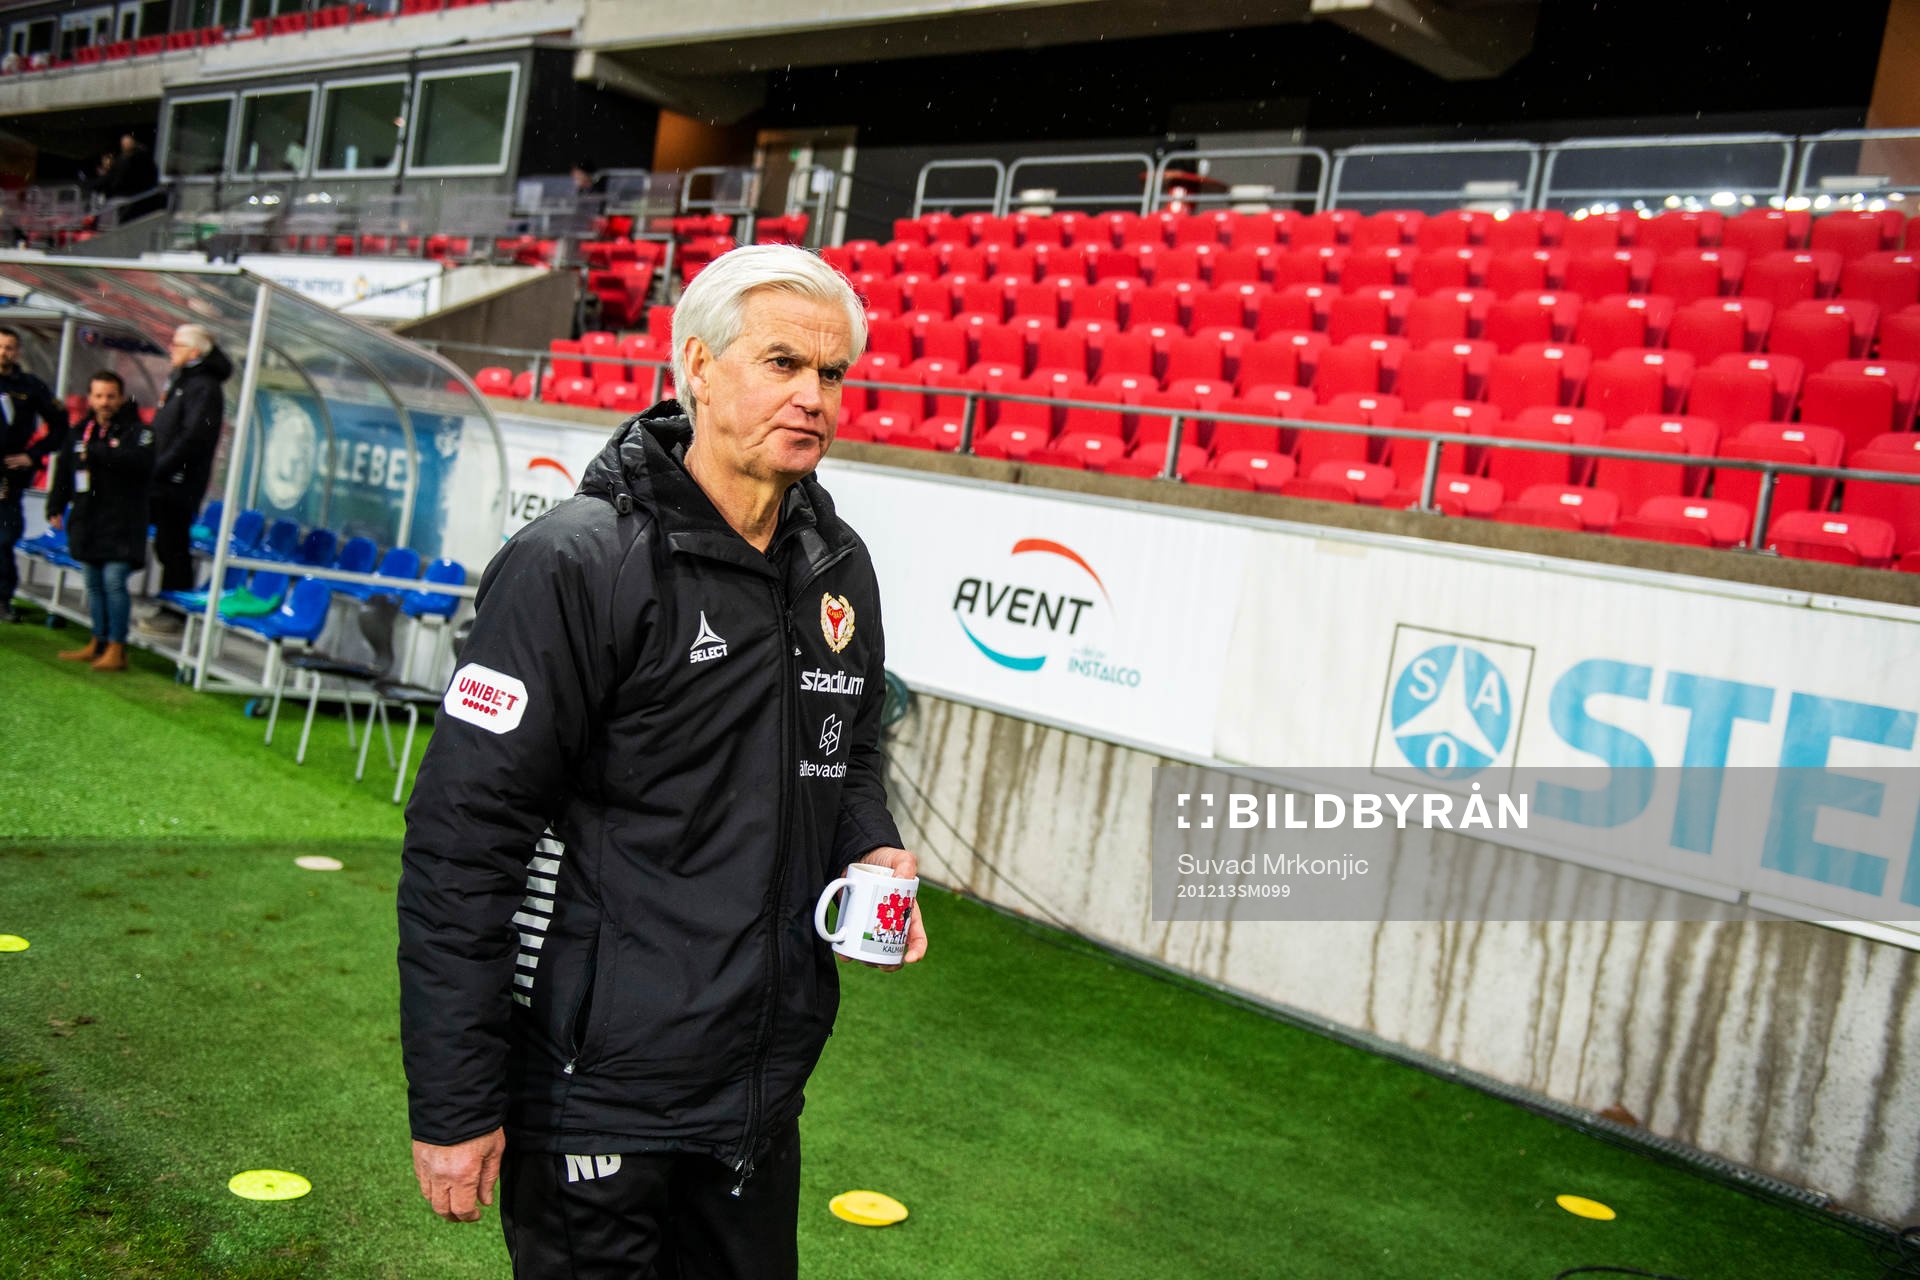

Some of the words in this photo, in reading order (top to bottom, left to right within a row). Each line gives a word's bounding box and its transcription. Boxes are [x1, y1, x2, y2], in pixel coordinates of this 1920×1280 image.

[953, 578, 1094, 635] AVENT
[690, 644, 728, 664] SELECT
[801, 668, 865, 695] stadium
[1068, 656, 1142, 688] INSTALCO
[458, 677, 519, 711] UNIBET
[800, 760, 847, 778] ältevadsh
